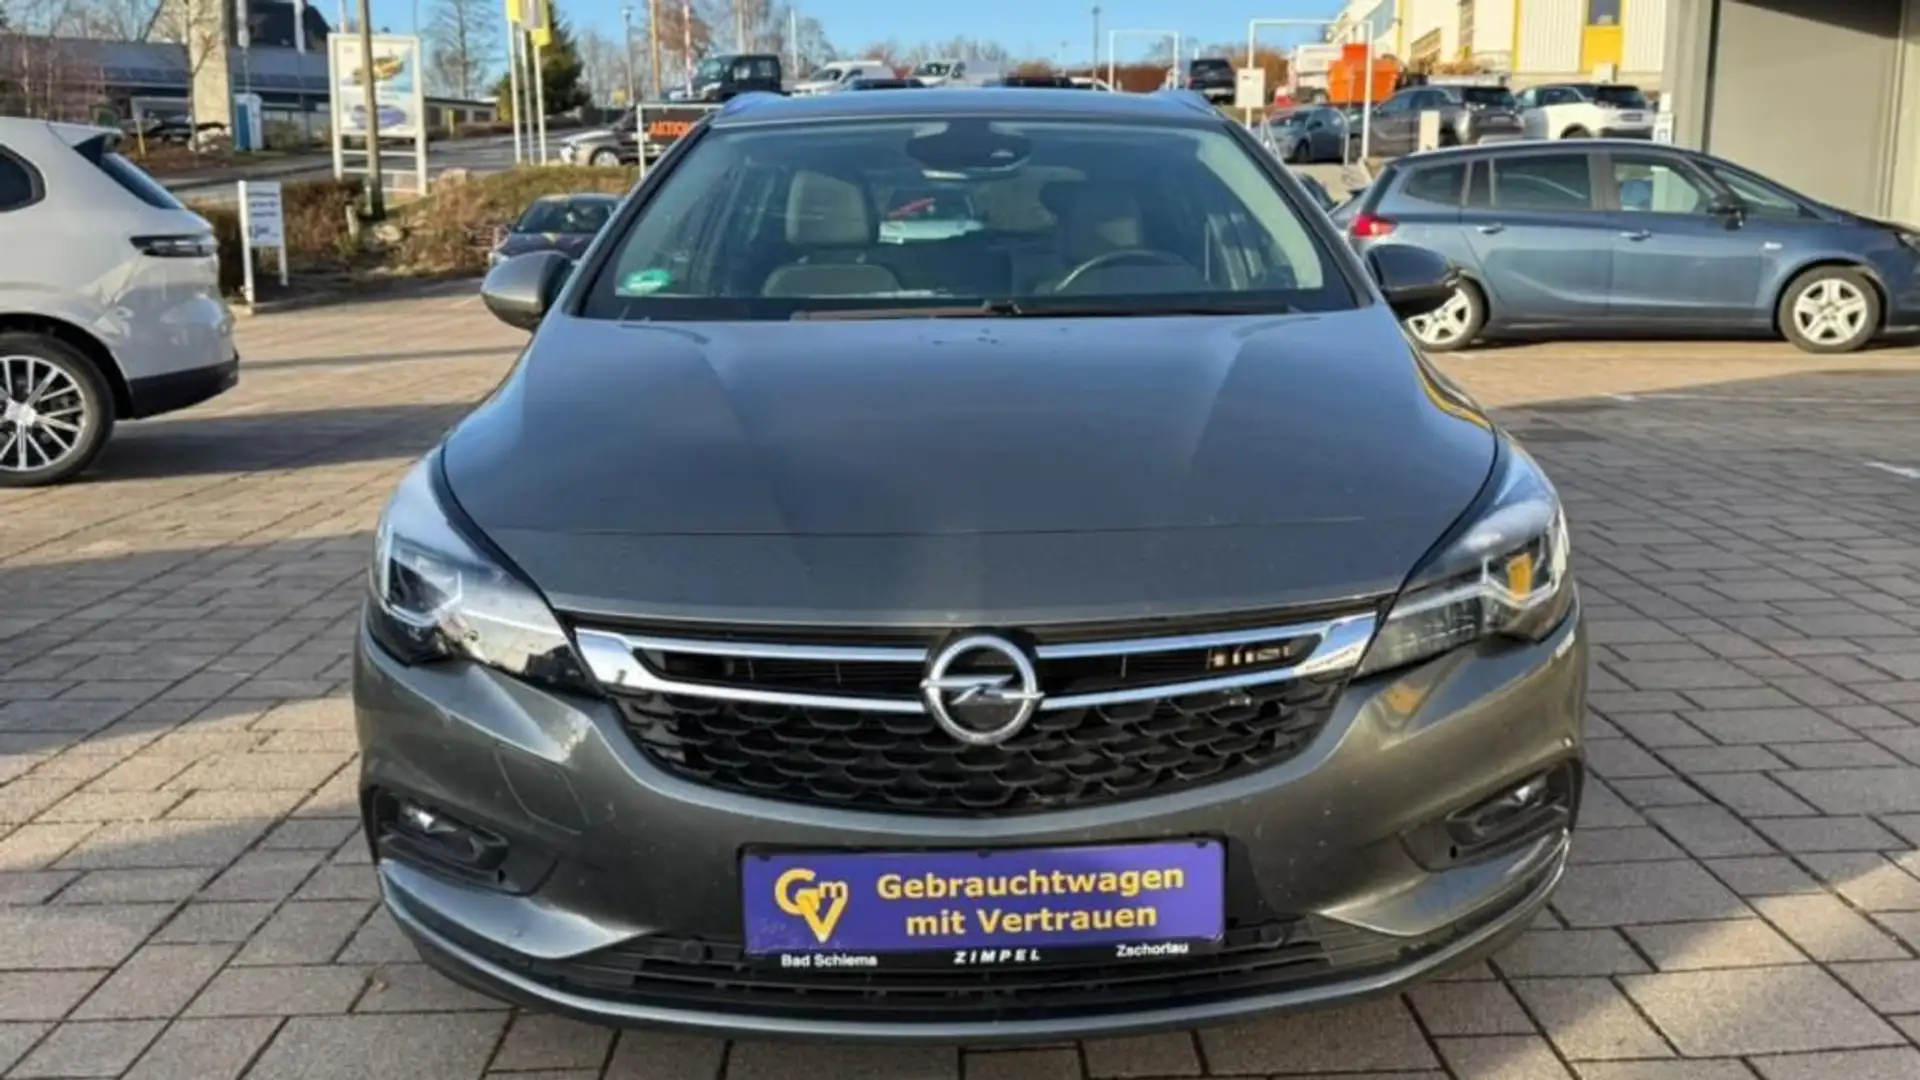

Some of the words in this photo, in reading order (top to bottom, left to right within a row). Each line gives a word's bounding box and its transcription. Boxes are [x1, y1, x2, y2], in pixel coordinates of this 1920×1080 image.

[876, 867, 1185, 900] Gebrauchtwagen
[906, 908, 967, 936] mit
[976, 904, 1157, 934] Vertrauen
[781, 953, 811, 968] Bad
[953, 947, 1041, 965] ZIMPEL
